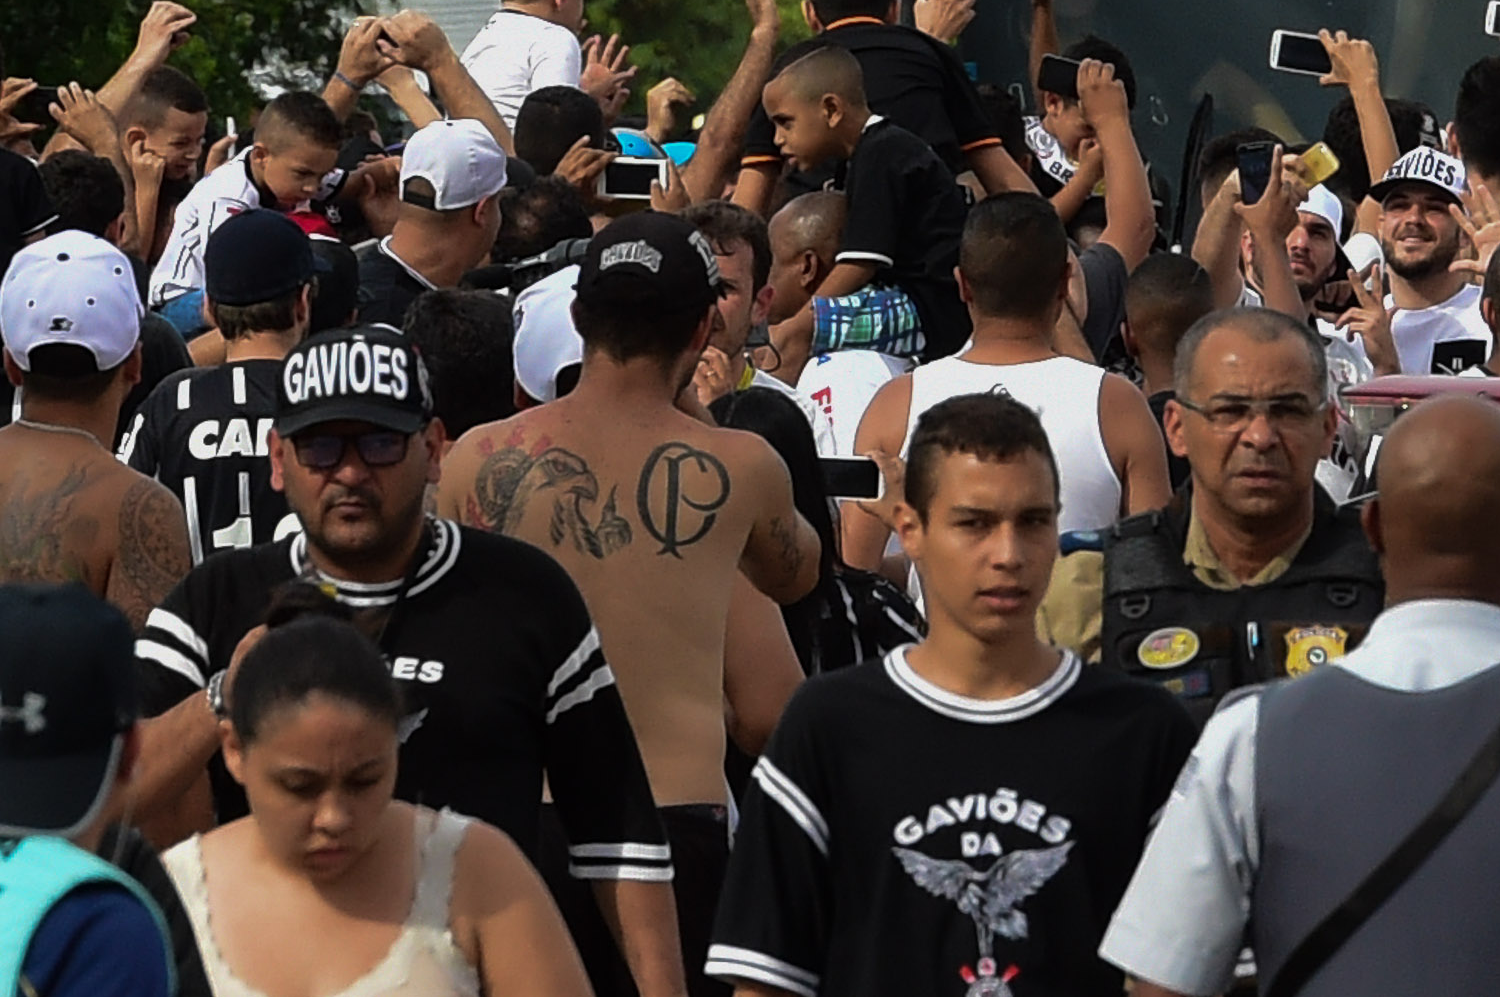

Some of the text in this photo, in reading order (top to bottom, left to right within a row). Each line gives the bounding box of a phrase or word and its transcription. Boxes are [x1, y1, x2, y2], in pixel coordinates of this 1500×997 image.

[283, 334, 409, 404] GAVIÕES
[893, 787, 1073, 845] GAVIÕES
[960, 831, 1003, 858] DA
